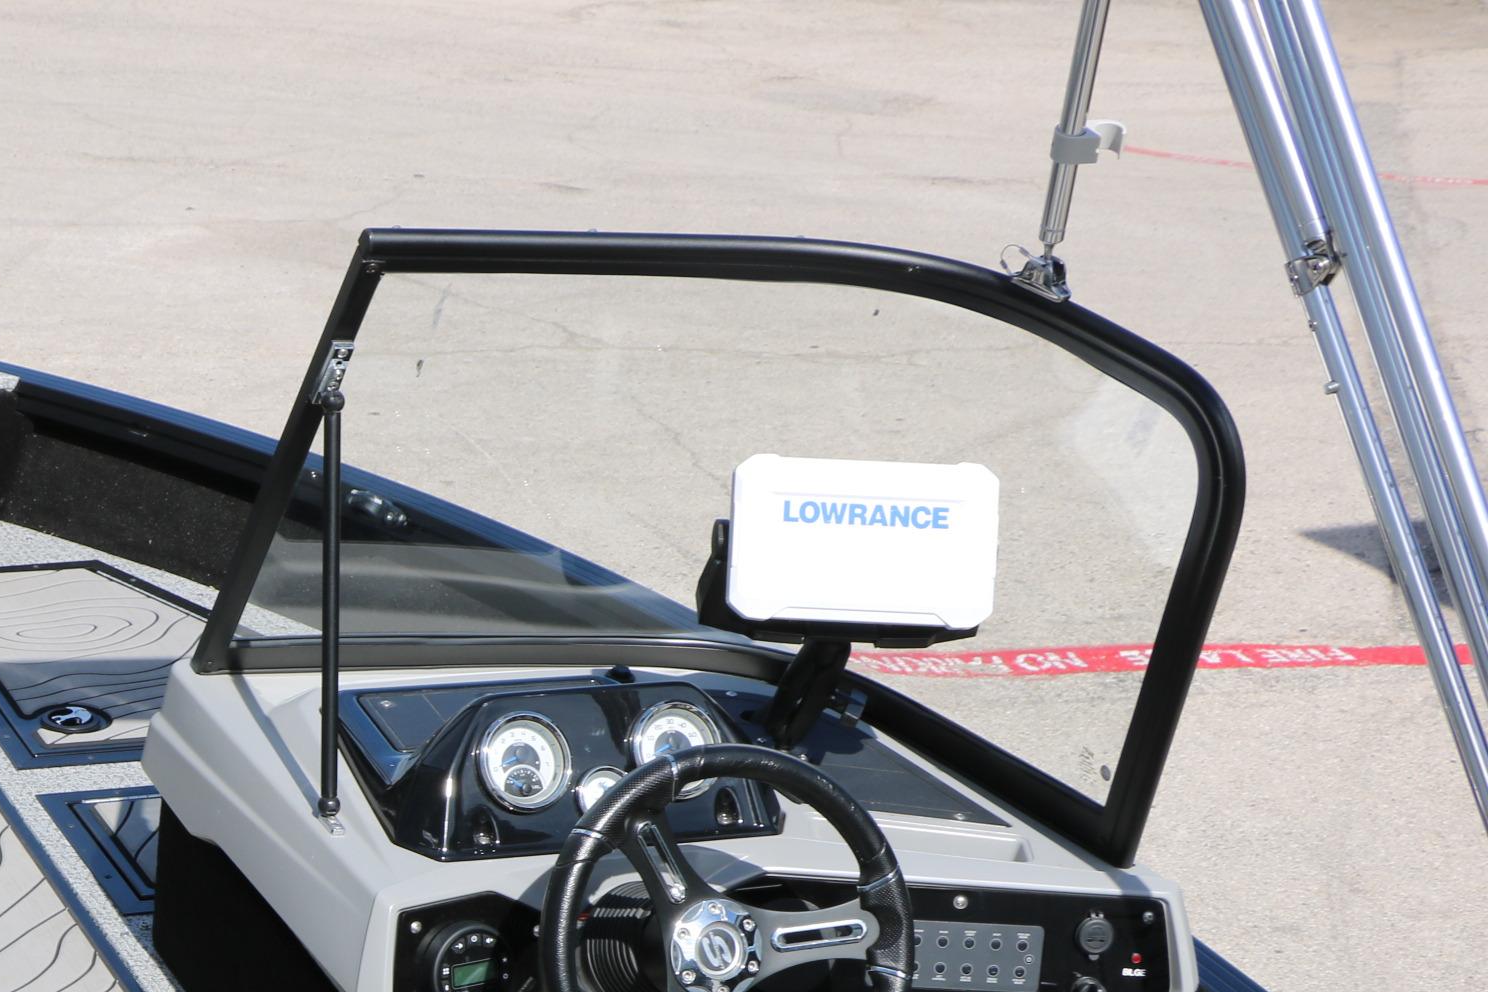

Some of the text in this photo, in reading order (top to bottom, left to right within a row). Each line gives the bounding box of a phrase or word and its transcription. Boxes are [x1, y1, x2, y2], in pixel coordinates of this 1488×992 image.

[783, 500, 950, 529] LOWRANCE
[1015, 651, 1088, 671] NO
[1118, 648, 1254, 665] LAE
[1122, 967, 1147, 977] BILGE
